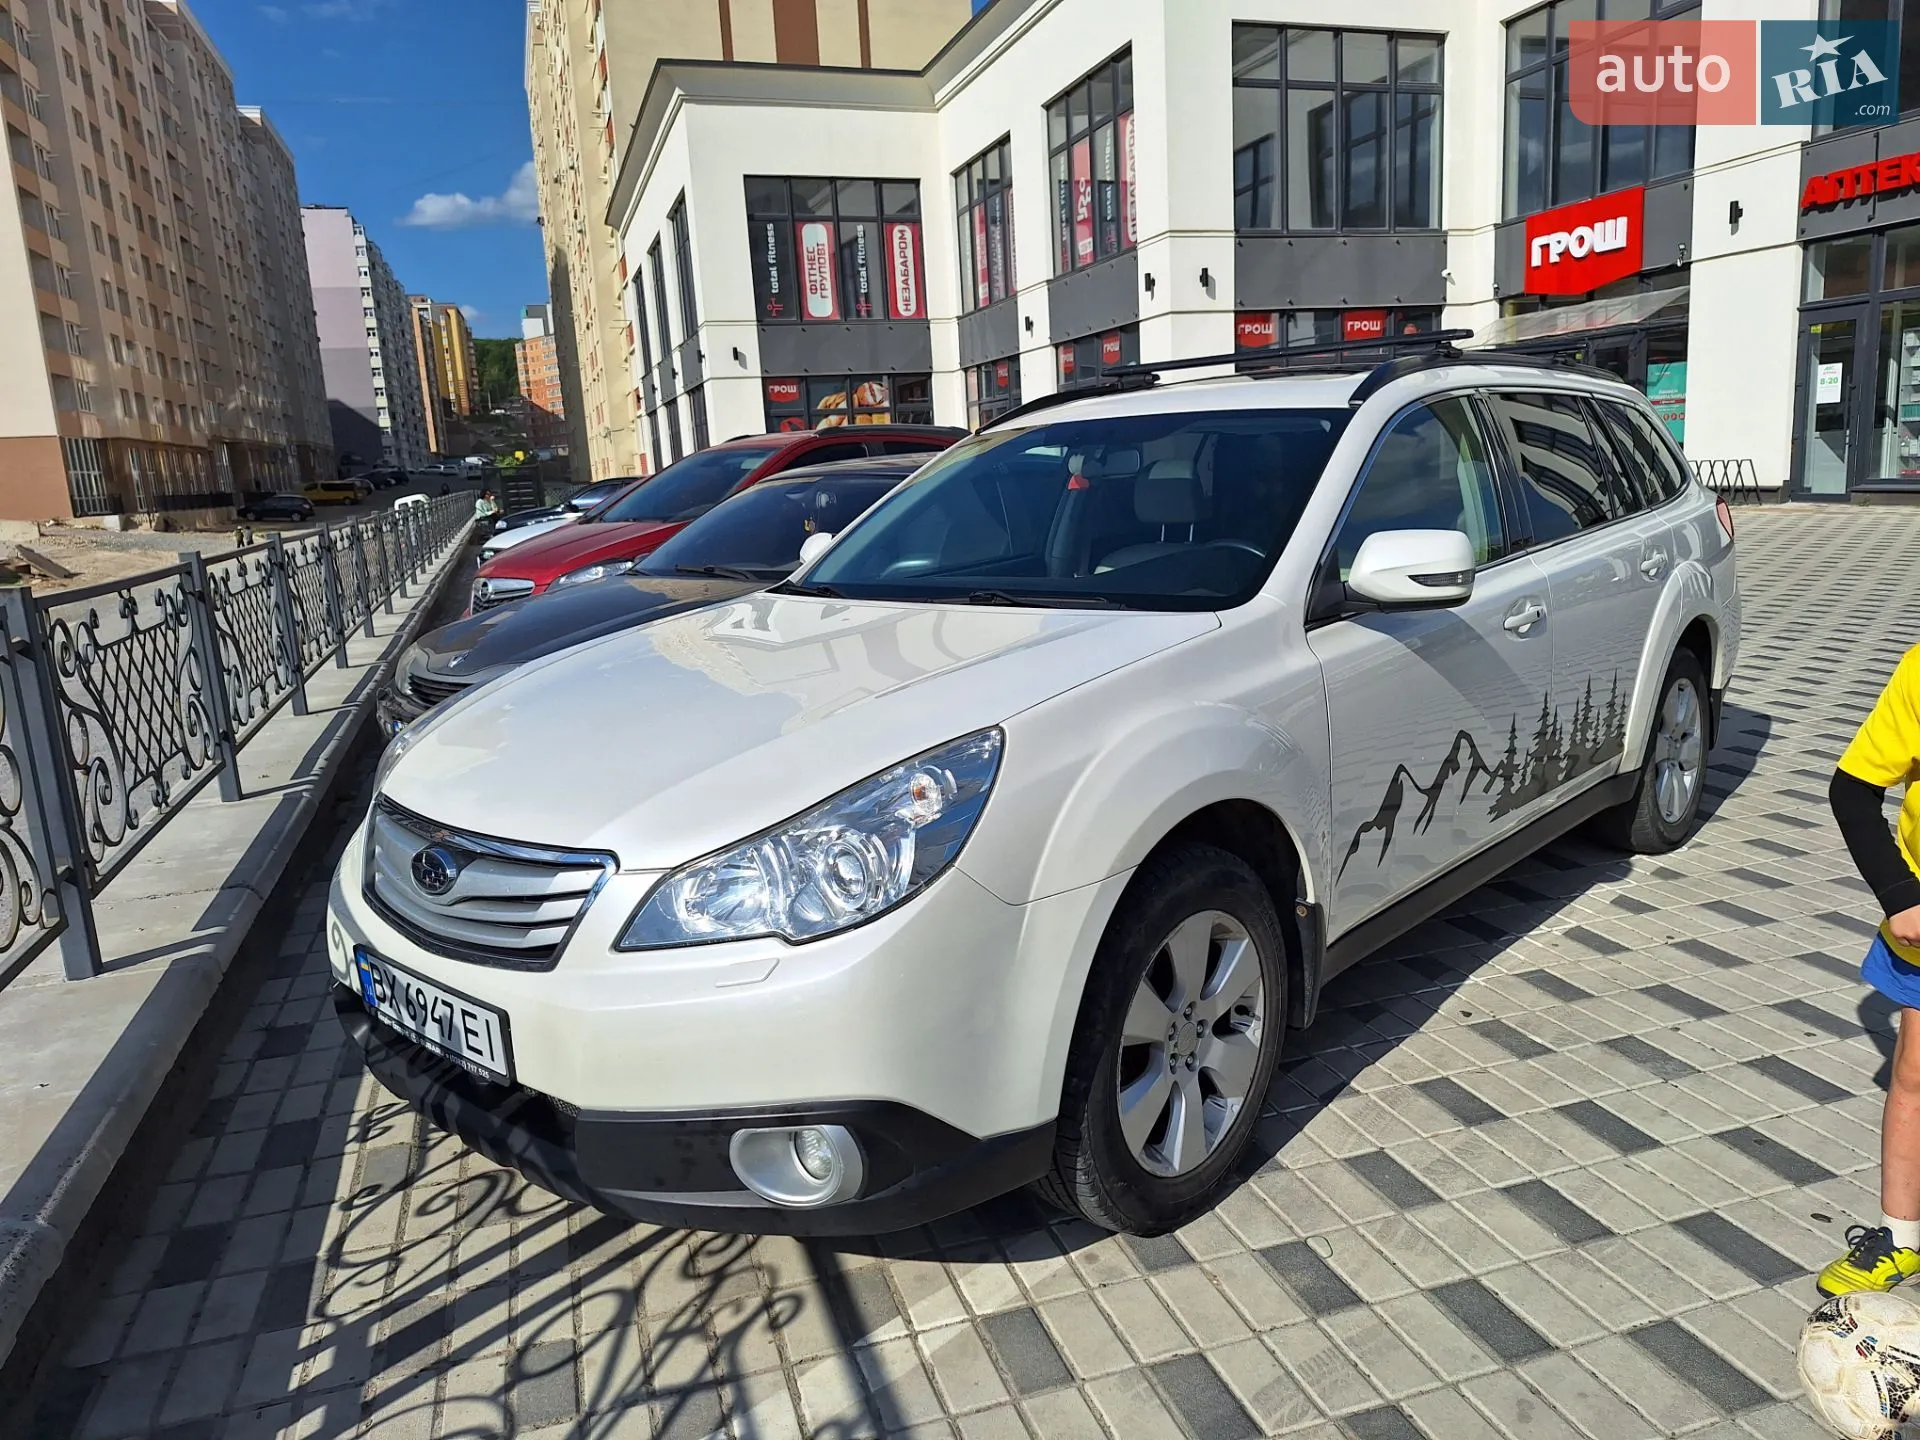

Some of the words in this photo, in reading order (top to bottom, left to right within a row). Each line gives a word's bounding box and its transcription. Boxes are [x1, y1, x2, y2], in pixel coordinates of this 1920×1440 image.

[766, 222, 777, 264] fitness
[856, 224, 866, 264] fitness
[1531, 216, 1628, 268] ГРОШ
[770, 266, 779, 294] total
[806, 246, 819, 296] ФІТНЕС
[816, 241, 829, 300] ГРУПОВІ
[860, 266, 868, 294] total
[898, 229, 912, 313] НЕЗАБАРОМ
[1236, 323, 1273, 335] ГРОШ
[1346, 319, 1381, 332] ГРОШ
[769, 384, 797, 394] ГРОШ
[369, 962, 402, 1016] BX
[405, 982, 455, 1041] 6947
